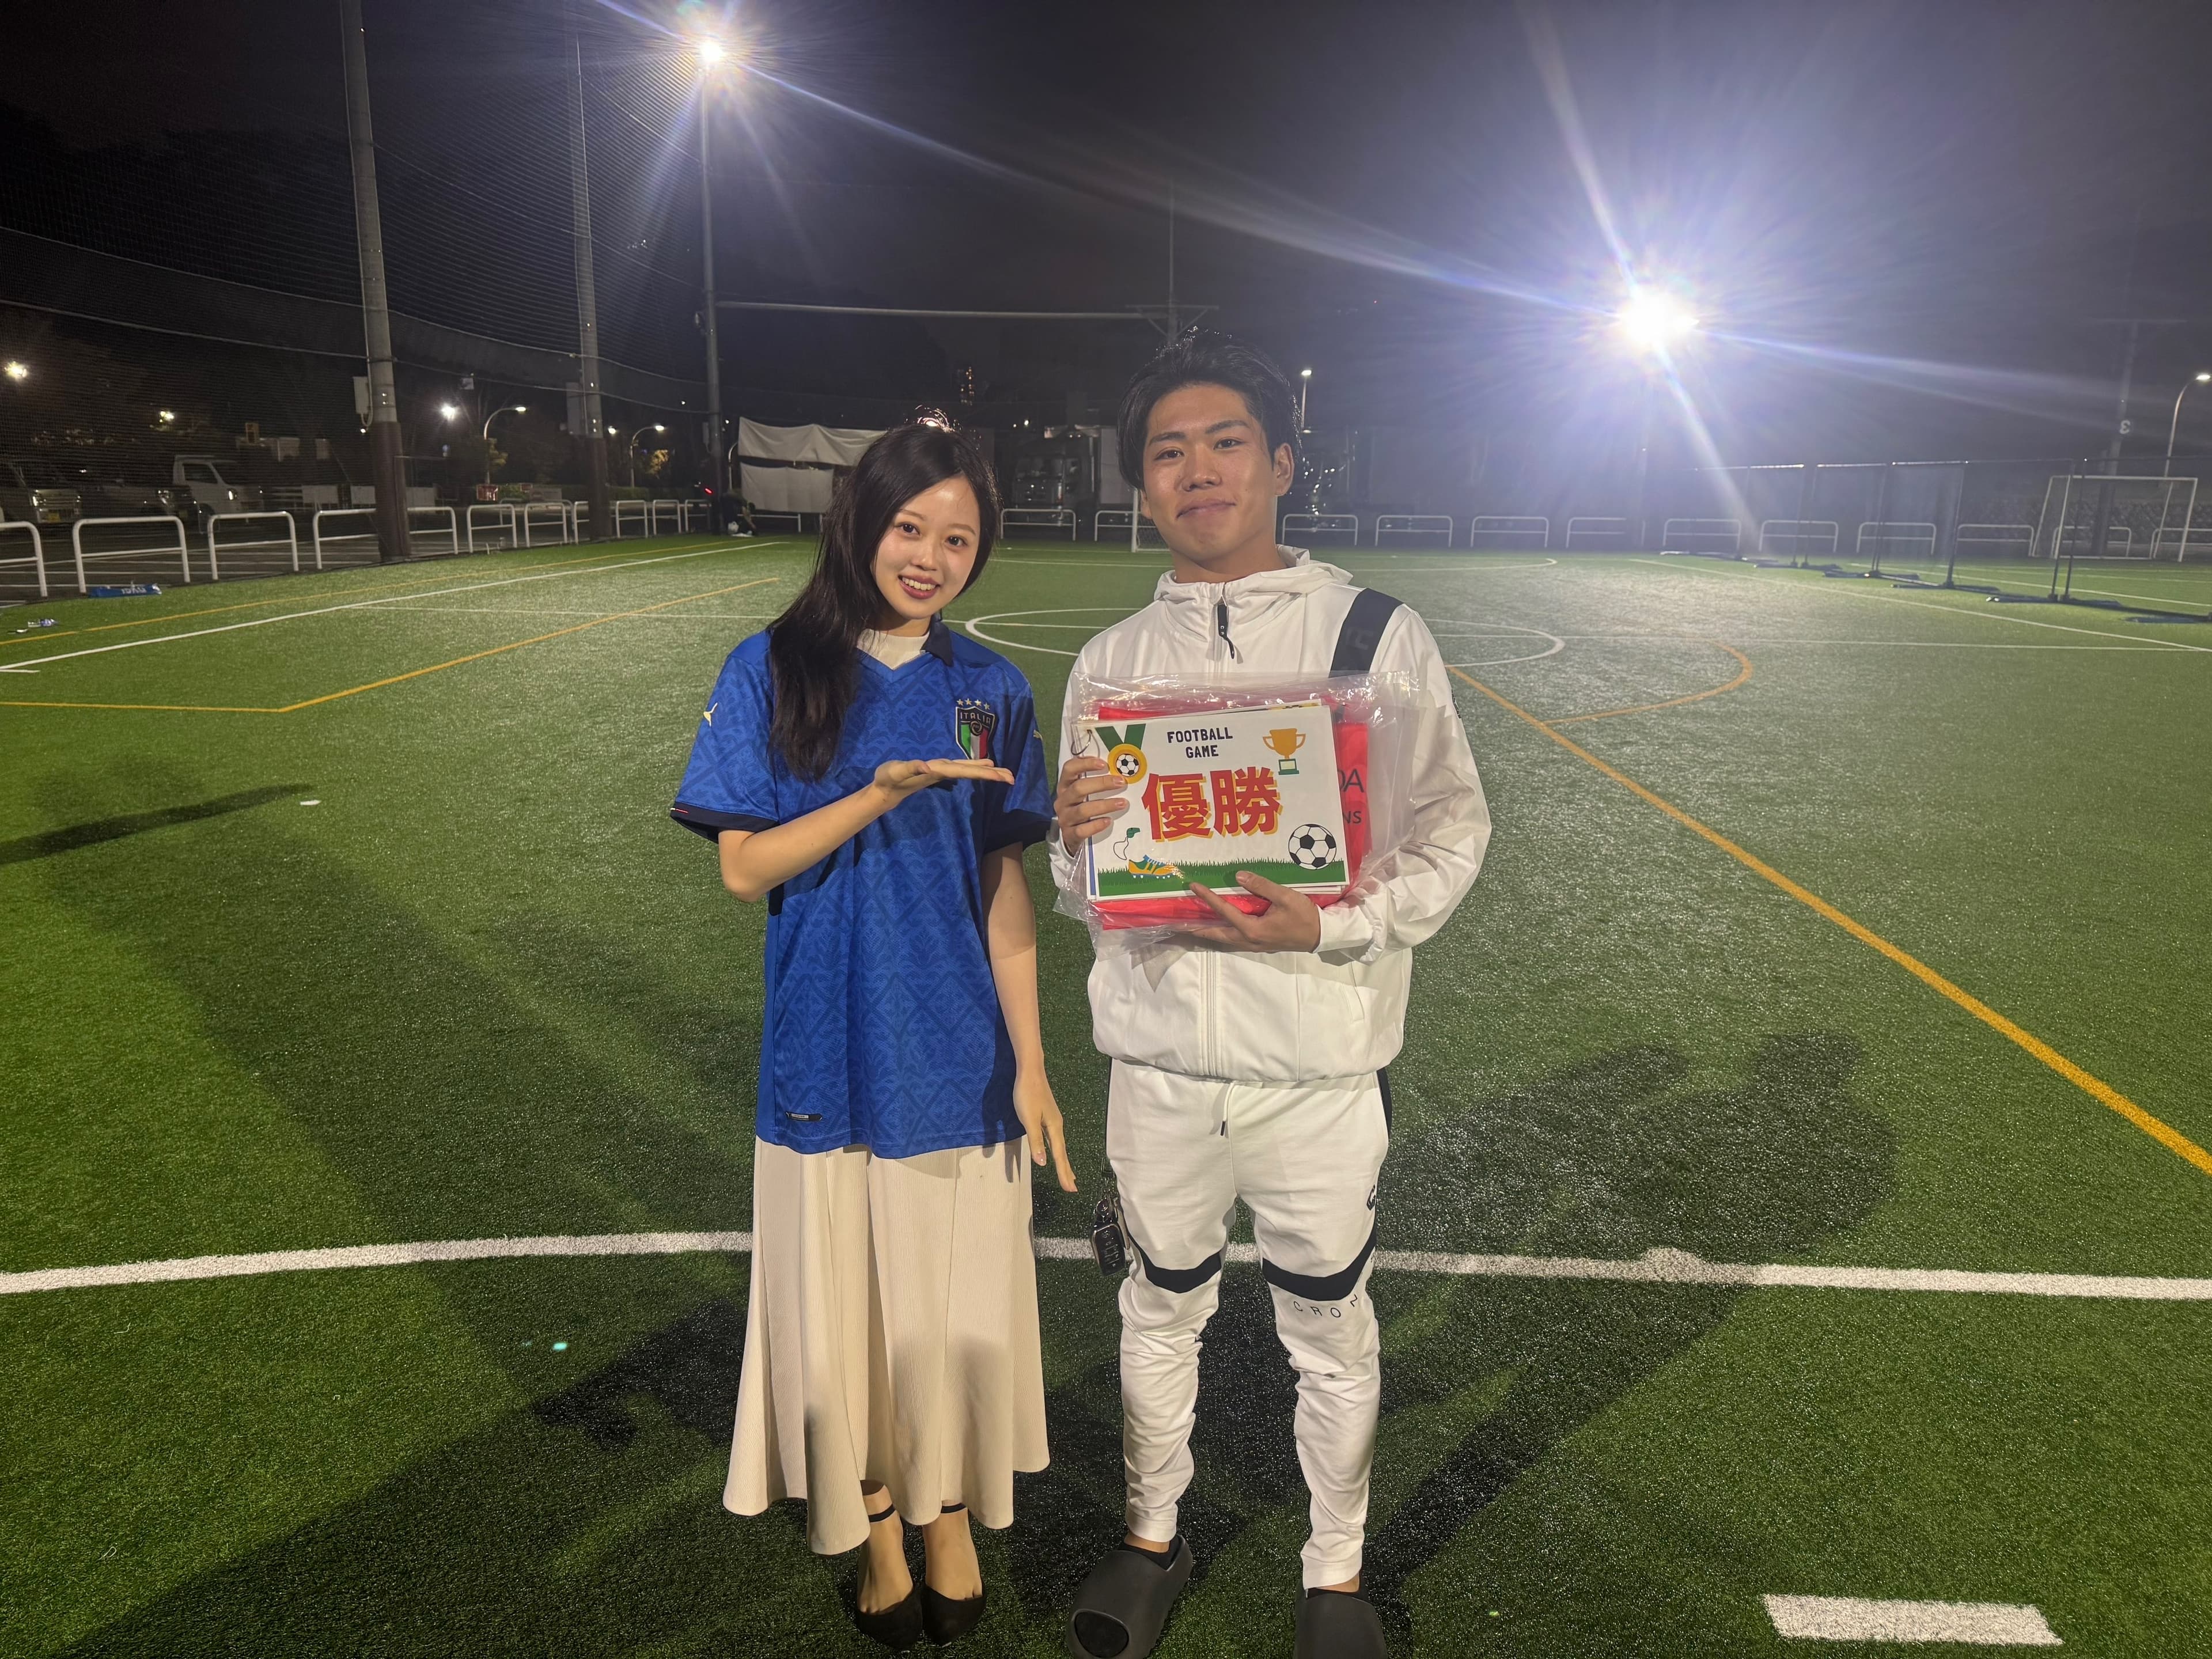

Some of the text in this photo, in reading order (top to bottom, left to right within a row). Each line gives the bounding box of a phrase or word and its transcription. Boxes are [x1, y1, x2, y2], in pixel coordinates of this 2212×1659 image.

[960, 711, 991, 725] ITALIA
[1167, 727, 1233, 743] FOOTBALL
[1185, 745, 1219, 759] GAME
[1141, 766, 1283, 842] 優勝
